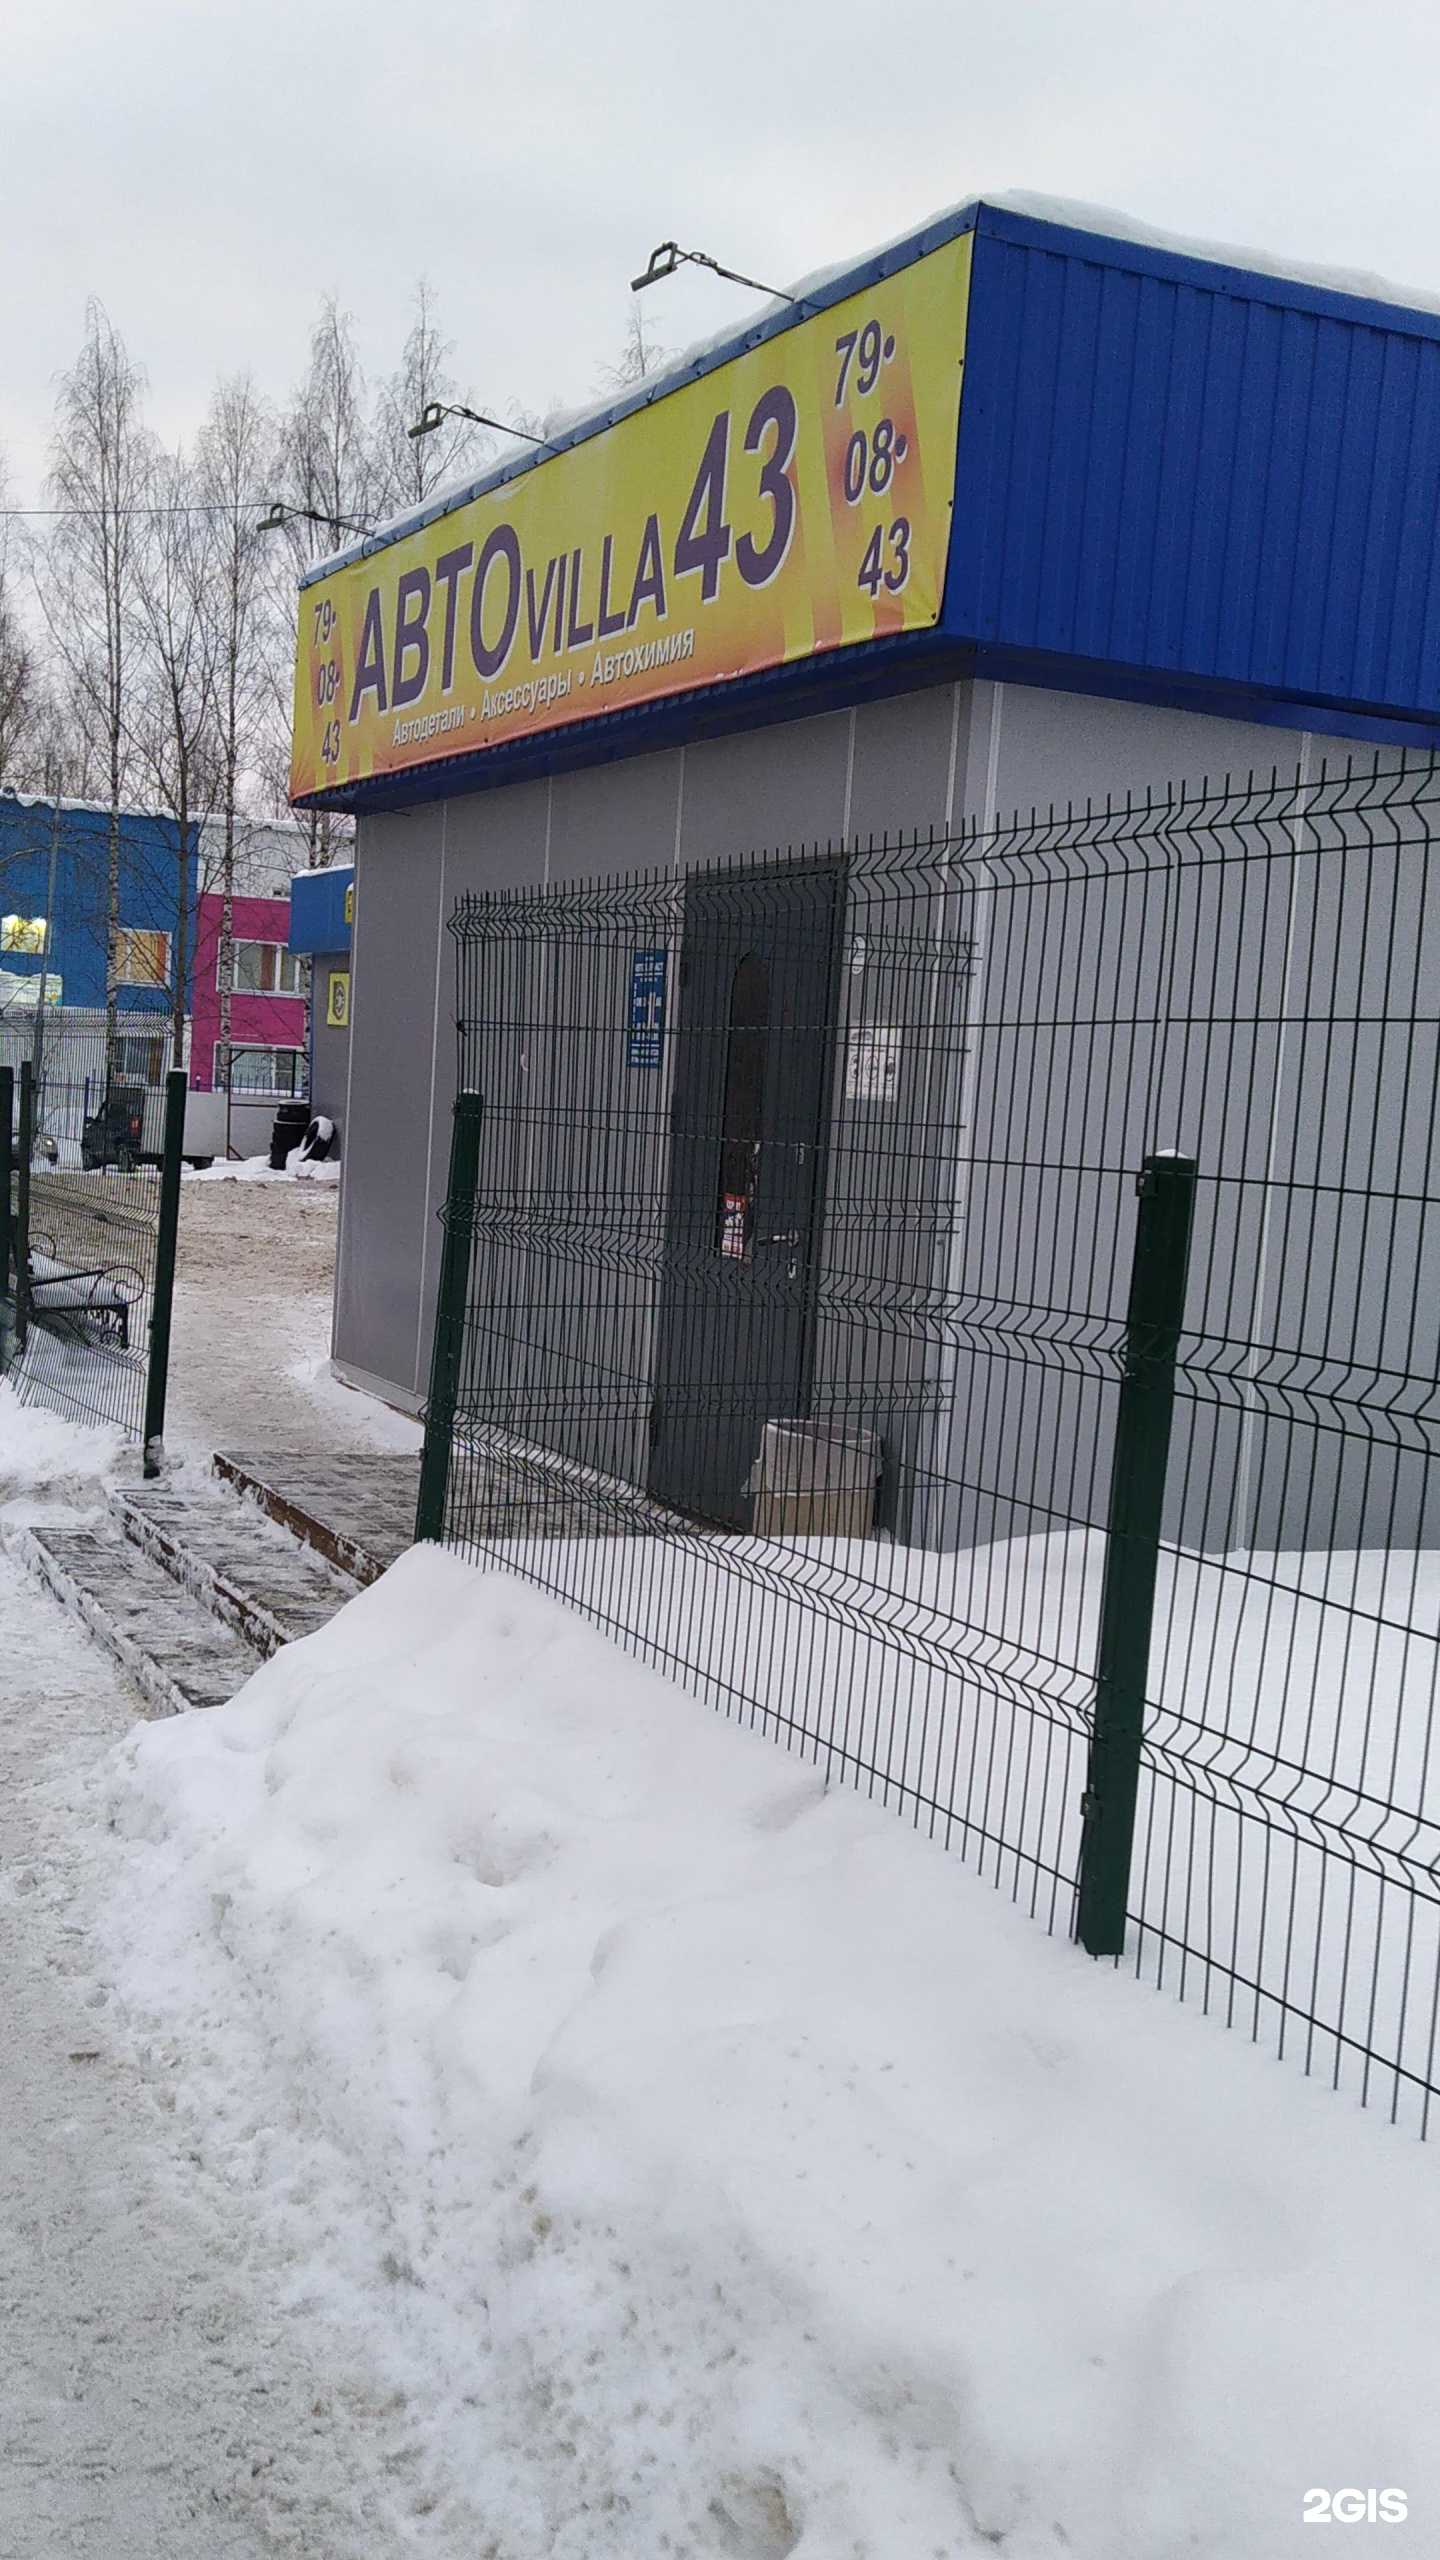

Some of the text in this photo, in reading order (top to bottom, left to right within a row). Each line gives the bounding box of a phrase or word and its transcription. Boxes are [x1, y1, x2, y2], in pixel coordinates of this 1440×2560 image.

[857, 517, 911, 600] 43
[392, 629, 695, 748] Автодетали Аксессуары Автохимия
[321, 719, 341, 765] 43
